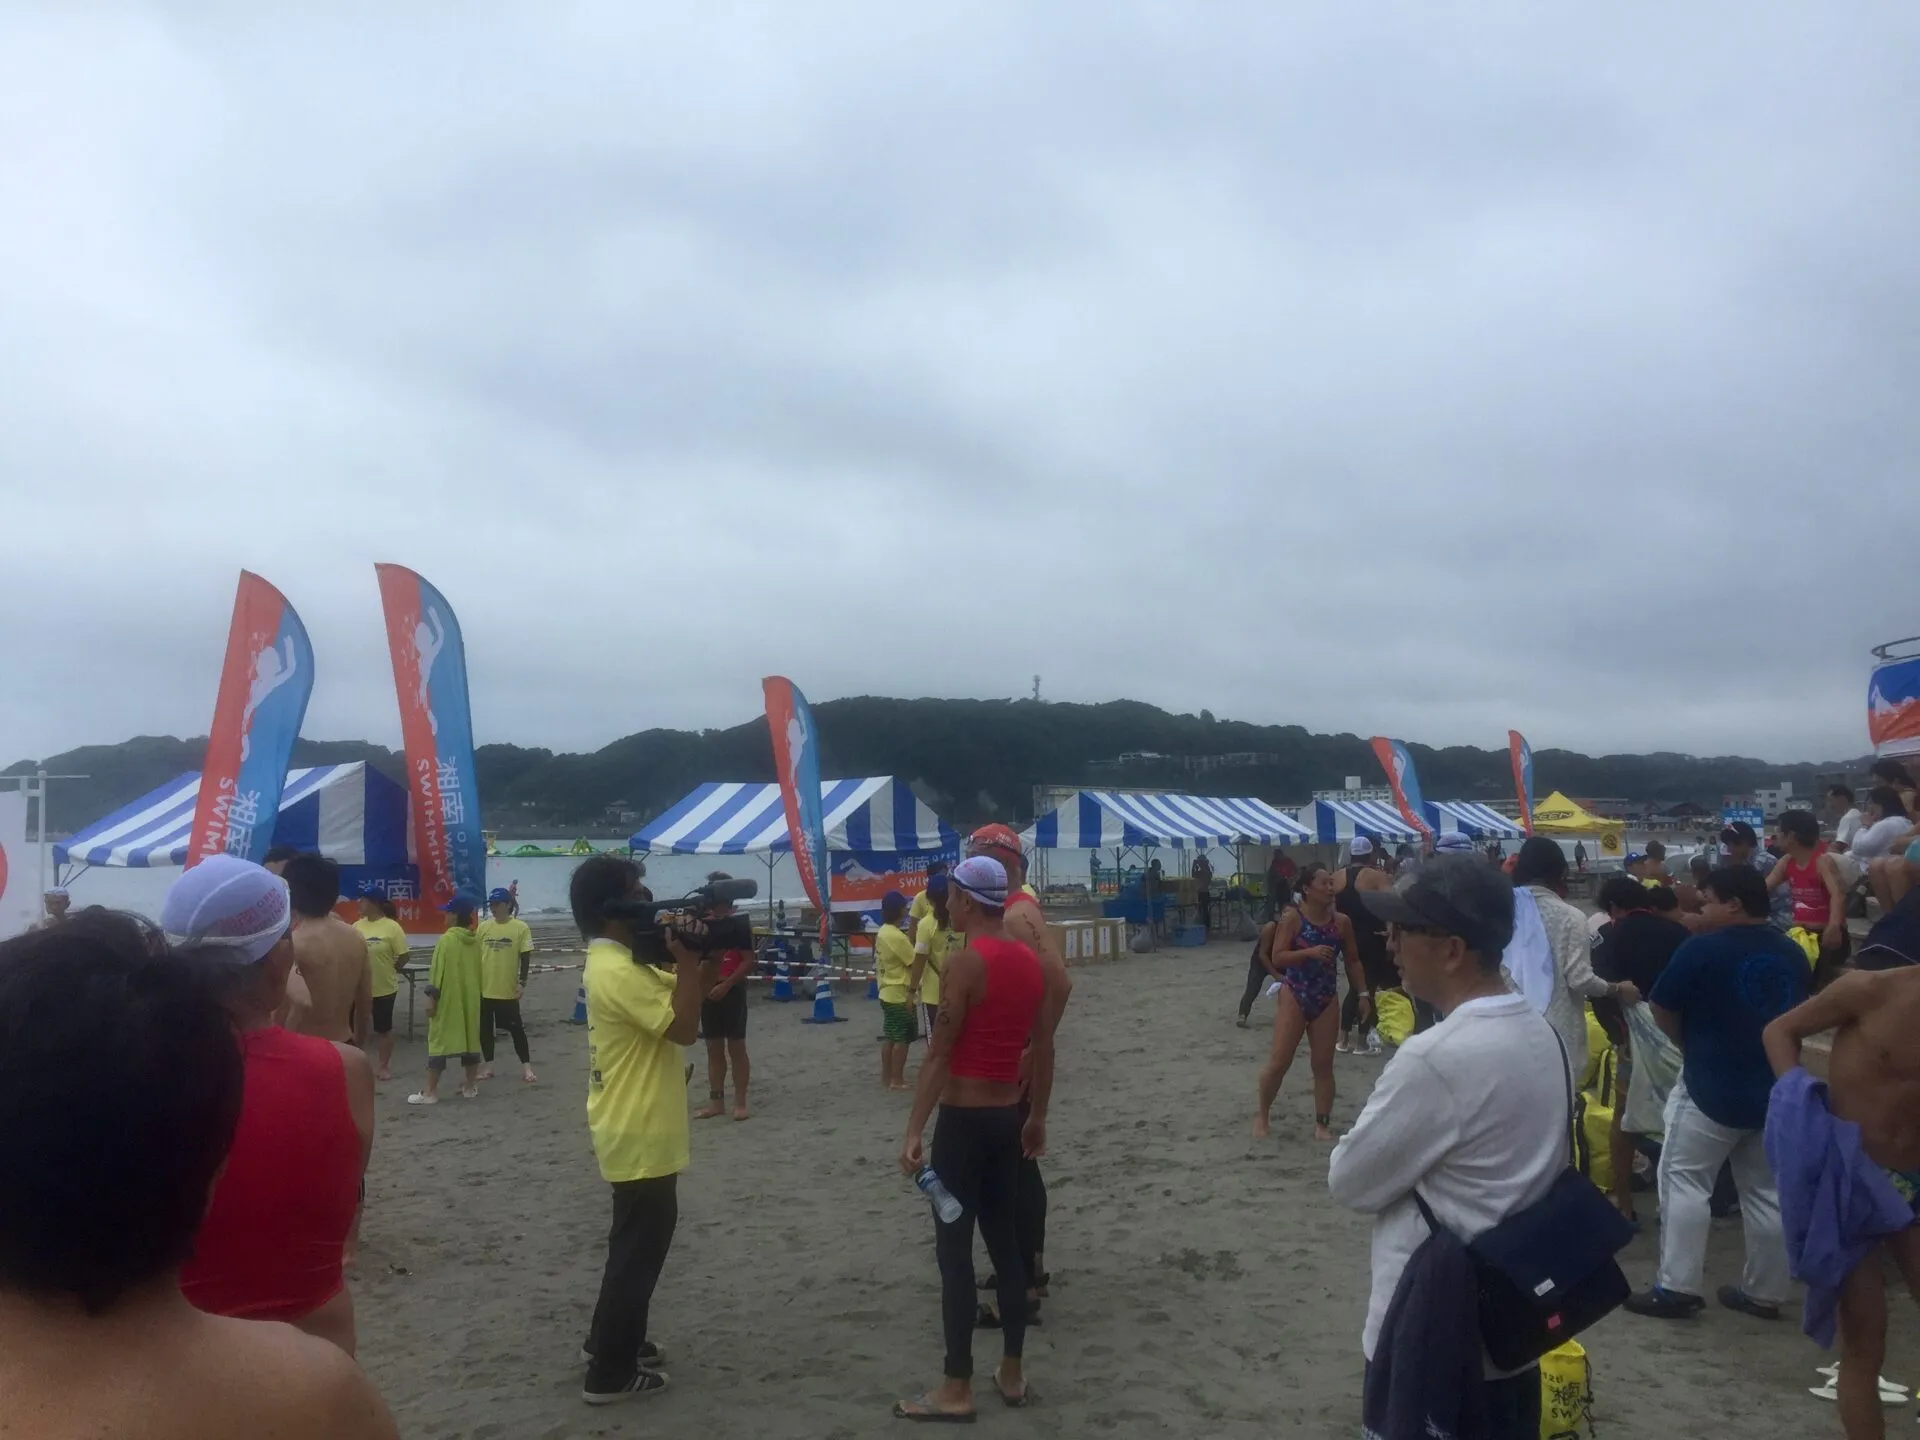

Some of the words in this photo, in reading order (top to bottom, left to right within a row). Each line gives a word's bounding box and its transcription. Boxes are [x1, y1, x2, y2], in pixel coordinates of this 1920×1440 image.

[200, 776, 233, 859] SWIM
[417, 758, 449, 892] SWIMMING
[435, 756, 464, 825] 湘南
[1534, 810, 1573, 821] EEN
[456, 831, 473, 888] OPEN
